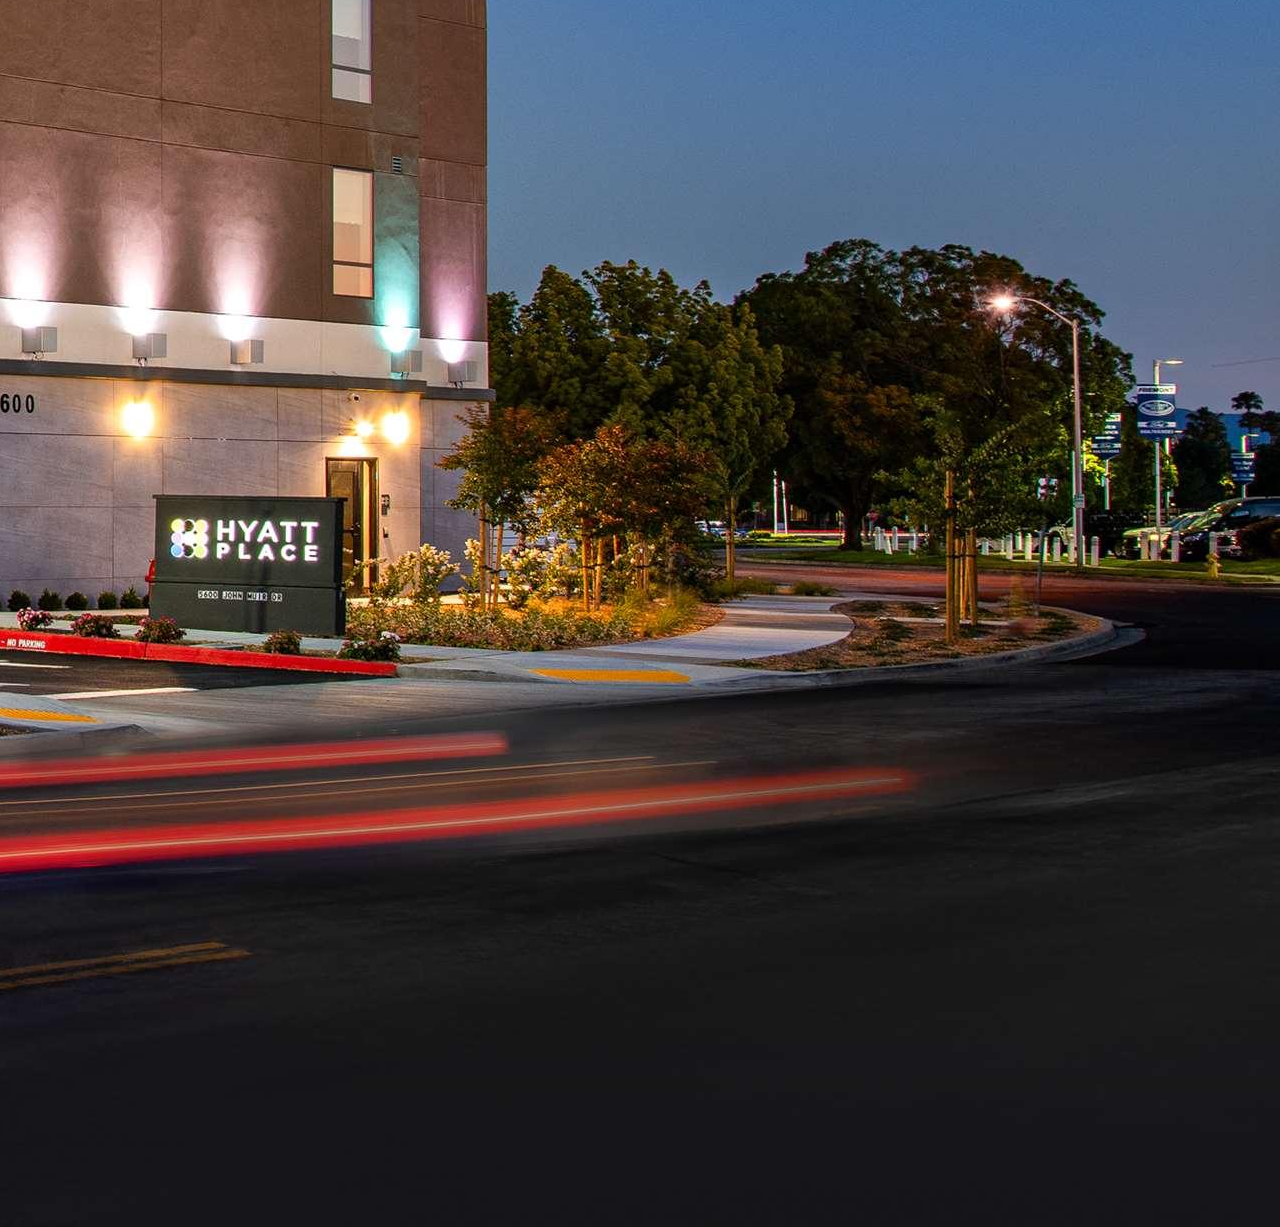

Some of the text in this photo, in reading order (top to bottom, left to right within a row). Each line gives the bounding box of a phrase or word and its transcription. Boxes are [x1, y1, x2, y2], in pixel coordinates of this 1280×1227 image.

[216, 520, 320, 544] HYATT
[216, 543, 319, 562] PLACE
[197, 590, 283, 602] 5600 JOHN MUIR DR
[6, 638, 17, 647] NO
[18, 638, 46, 649] PARKING
